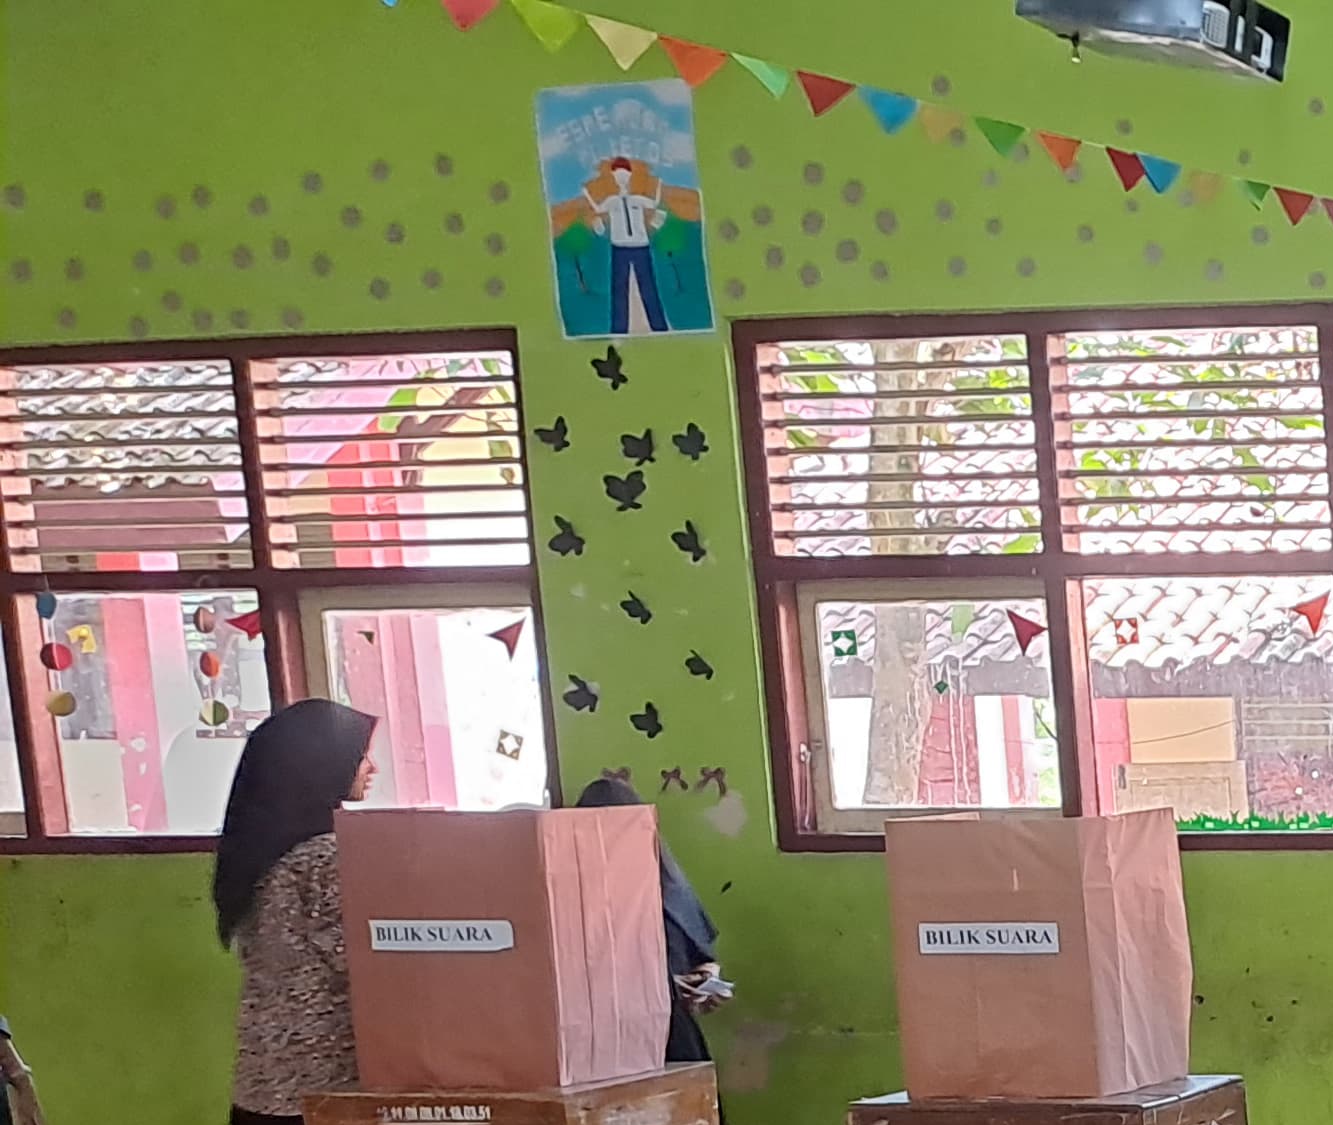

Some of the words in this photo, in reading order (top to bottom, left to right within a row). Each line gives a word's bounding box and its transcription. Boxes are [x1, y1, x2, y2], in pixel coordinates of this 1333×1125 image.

[376, 926, 423, 942] BILIK
[427, 926, 493, 942] SUARA
[925, 930, 981, 945] BILIK
[986, 929, 1053, 945] SUARA
